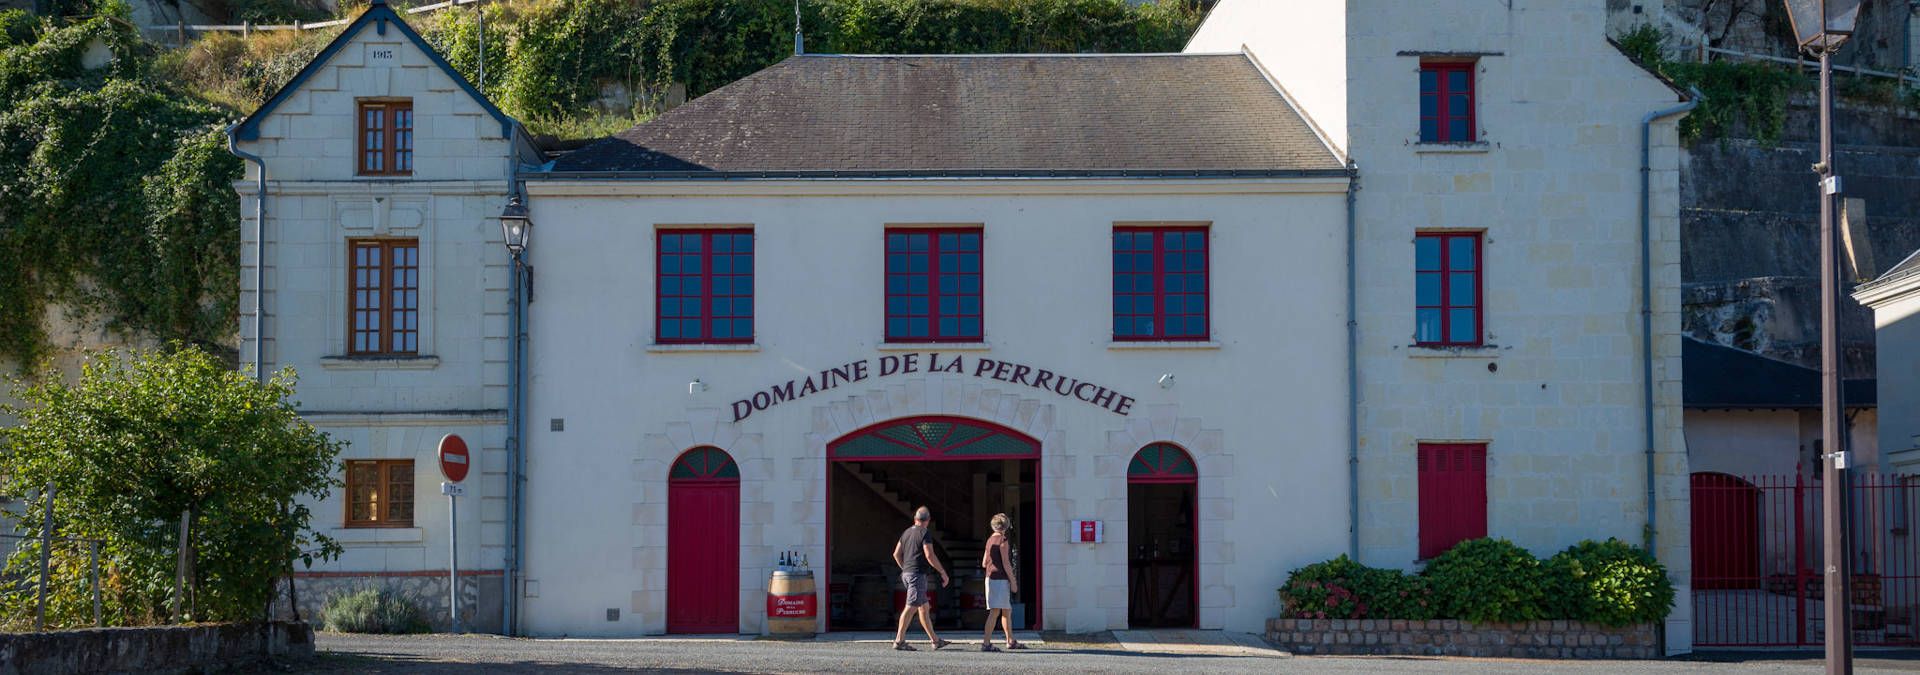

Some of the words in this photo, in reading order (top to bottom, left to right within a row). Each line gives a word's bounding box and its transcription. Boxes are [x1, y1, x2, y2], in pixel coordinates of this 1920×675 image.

[731, 359, 868, 423] DOMAINE
[878, 352, 919, 377] DE
[927, 352, 964, 374] LA
[973, 357, 1136, 416] PERRUCHE
